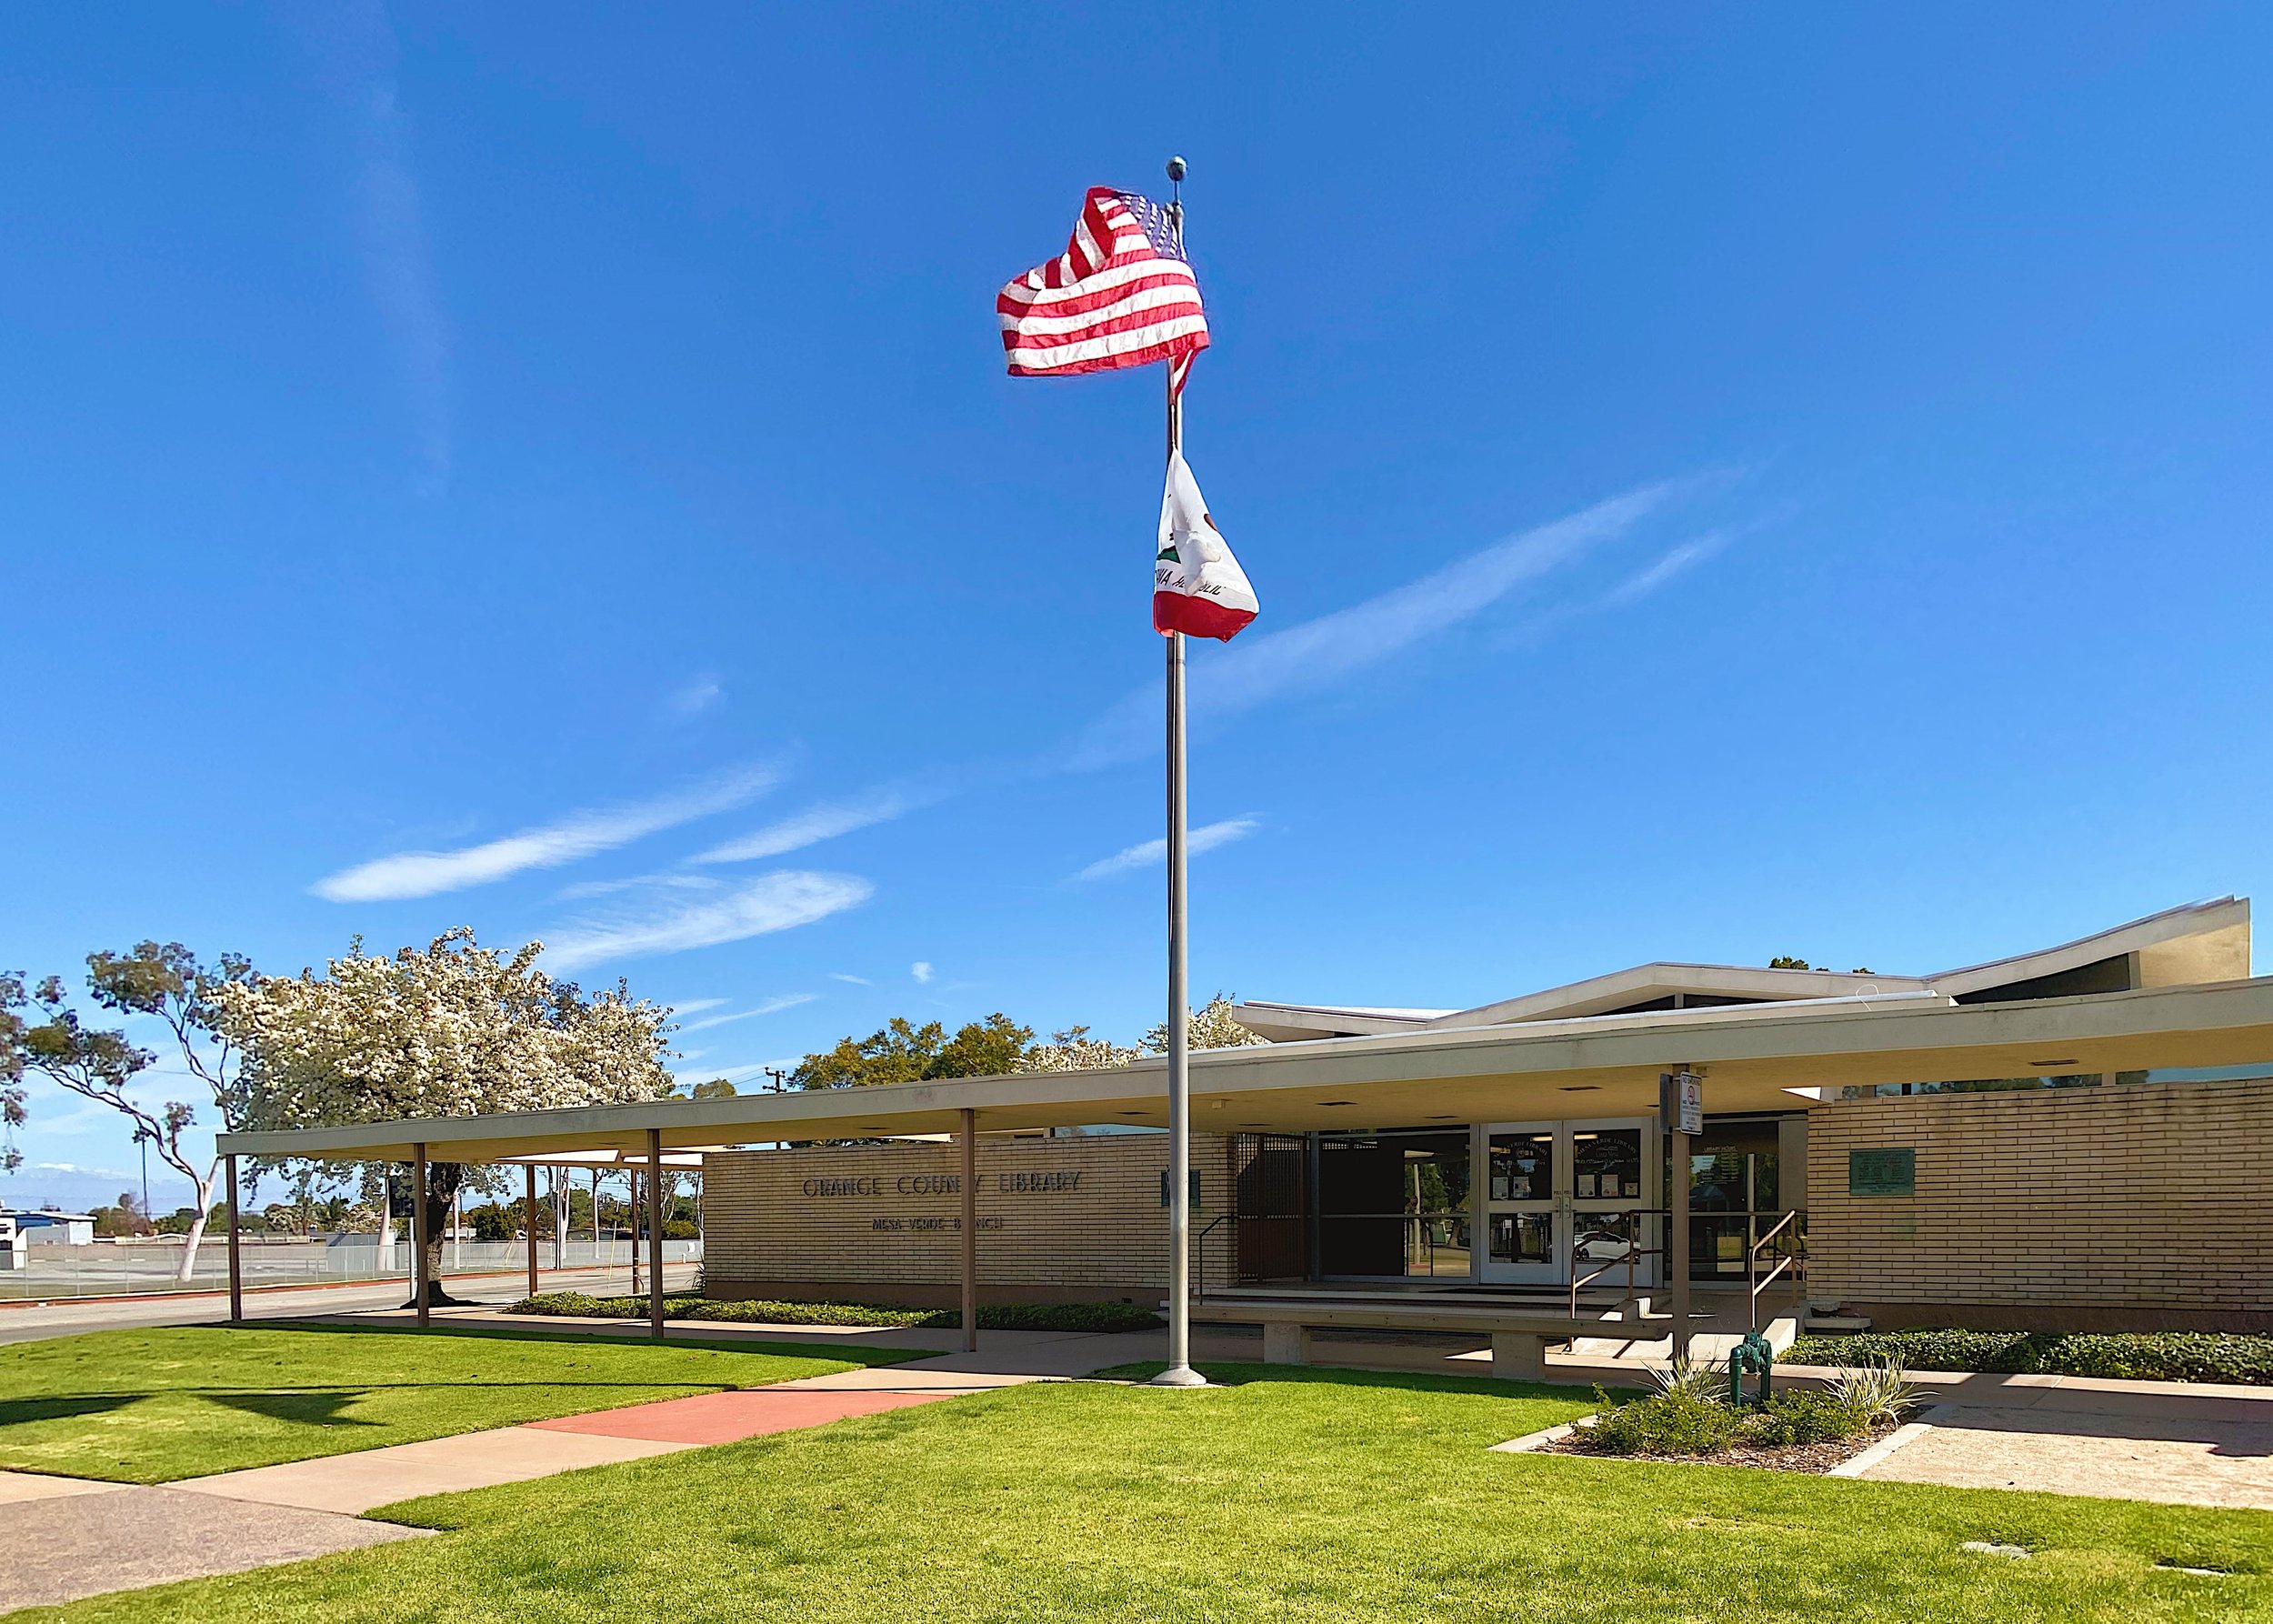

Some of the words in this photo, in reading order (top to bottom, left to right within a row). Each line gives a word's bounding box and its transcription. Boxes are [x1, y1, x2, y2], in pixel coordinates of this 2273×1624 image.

[803, 1177, 882, 1197] ORANGE
[897, 1175, 983, 1195] COUNY
[998, 1170, 1082, 1194] LIBRARY
[872, 1218, 902, 1230] MESA
[908, 1217, 946, 1230] VERDE
[954, 1217, 1004, 1229] BNCH
